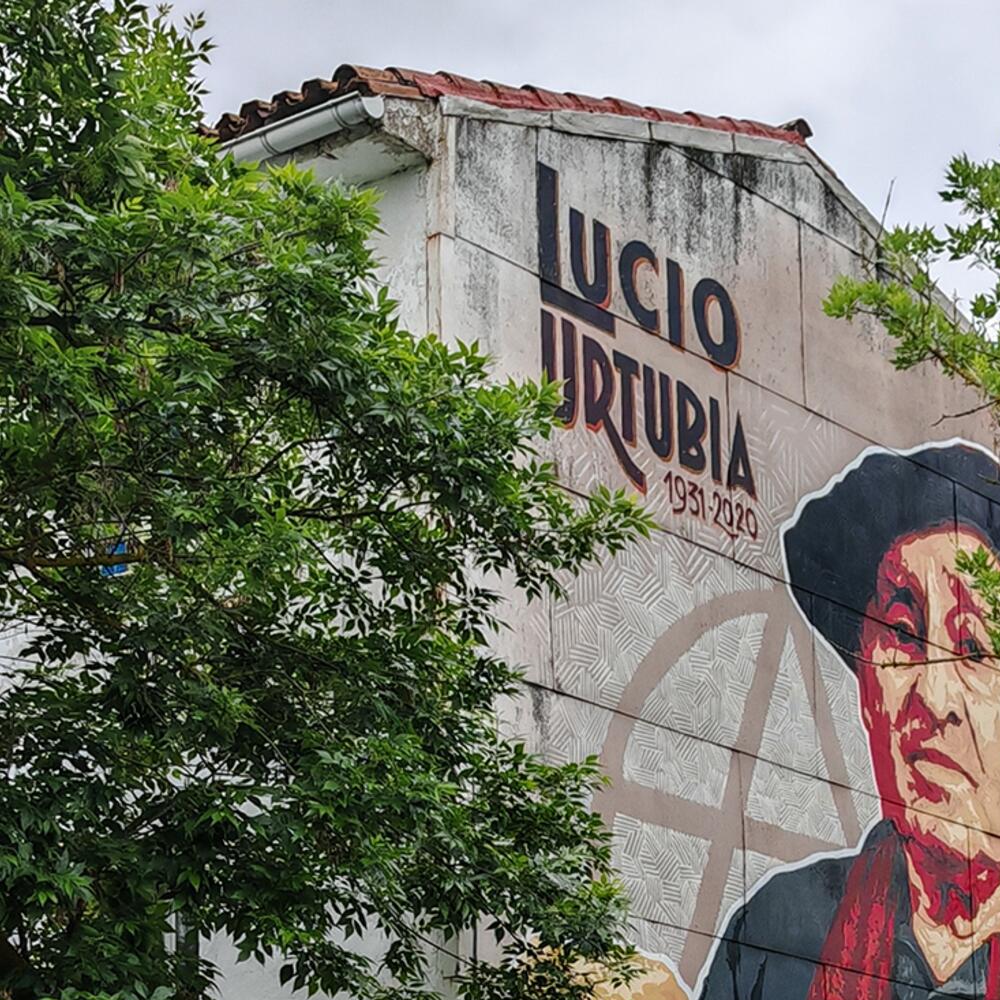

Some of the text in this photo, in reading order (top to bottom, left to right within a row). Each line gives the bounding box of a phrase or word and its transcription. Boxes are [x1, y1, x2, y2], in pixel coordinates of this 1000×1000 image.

[537, 161, 742, 370] LUCIO
[540, 308, 758, 502] URTUBIA
[663, 470, 758, 540] 1931-2020
